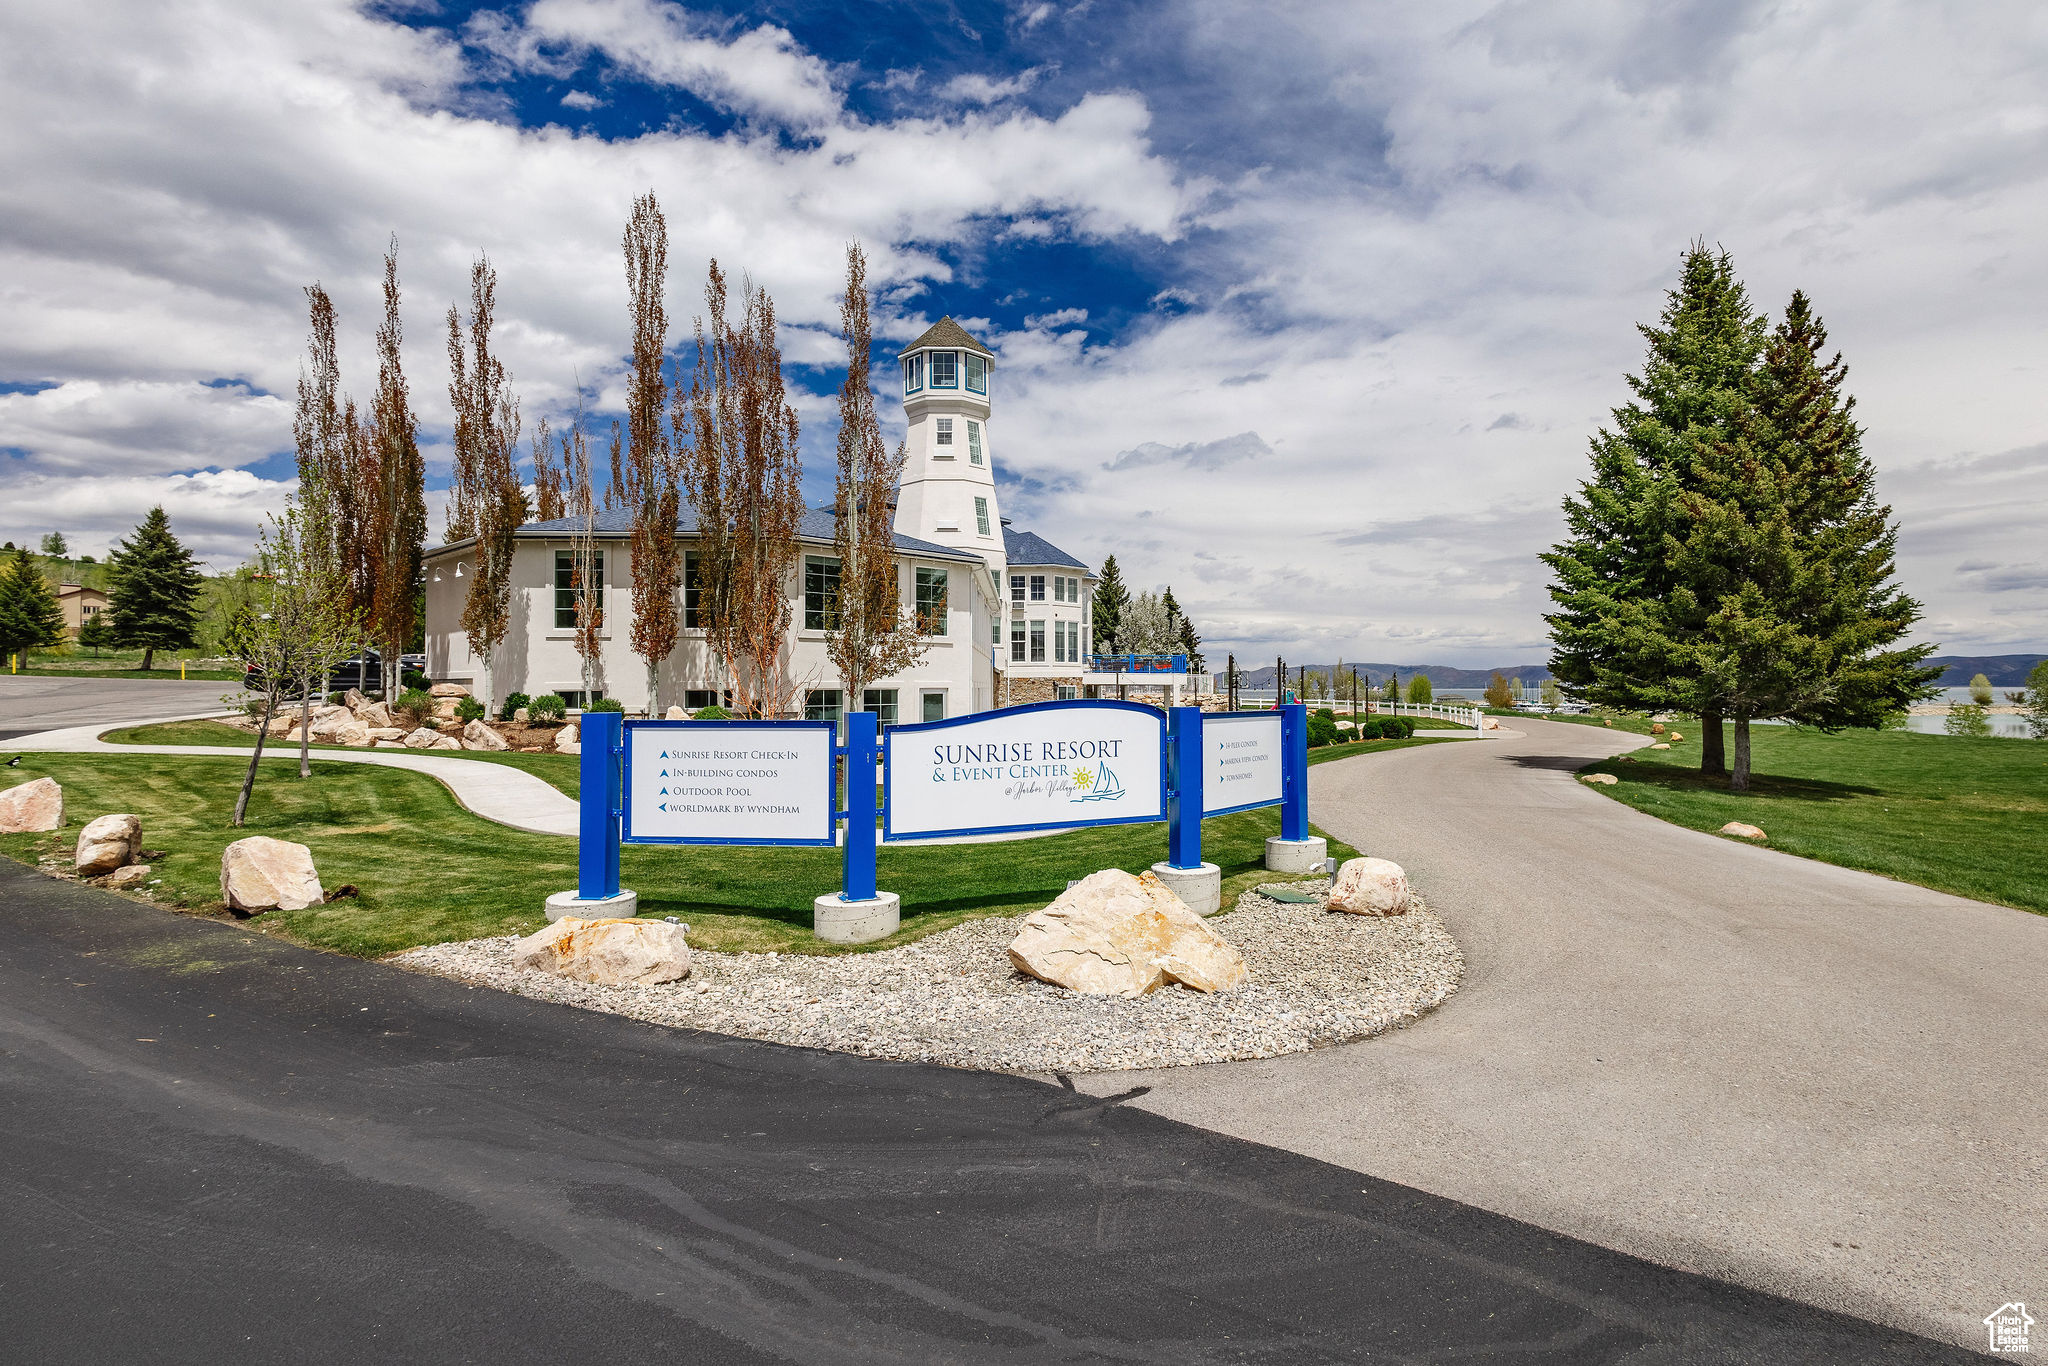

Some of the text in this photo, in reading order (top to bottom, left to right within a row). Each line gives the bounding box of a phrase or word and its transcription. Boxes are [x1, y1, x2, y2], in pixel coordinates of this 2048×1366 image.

[933, 739, 1123, 765] SUNRISE RESORT
[736, 769, 778, 778] CONDOS
[932, 767, 946, 782] &
[1045, 779, 1077, 798] Village
[669, 804, 800, 814] WORLDMARK BY WYNDHAM
